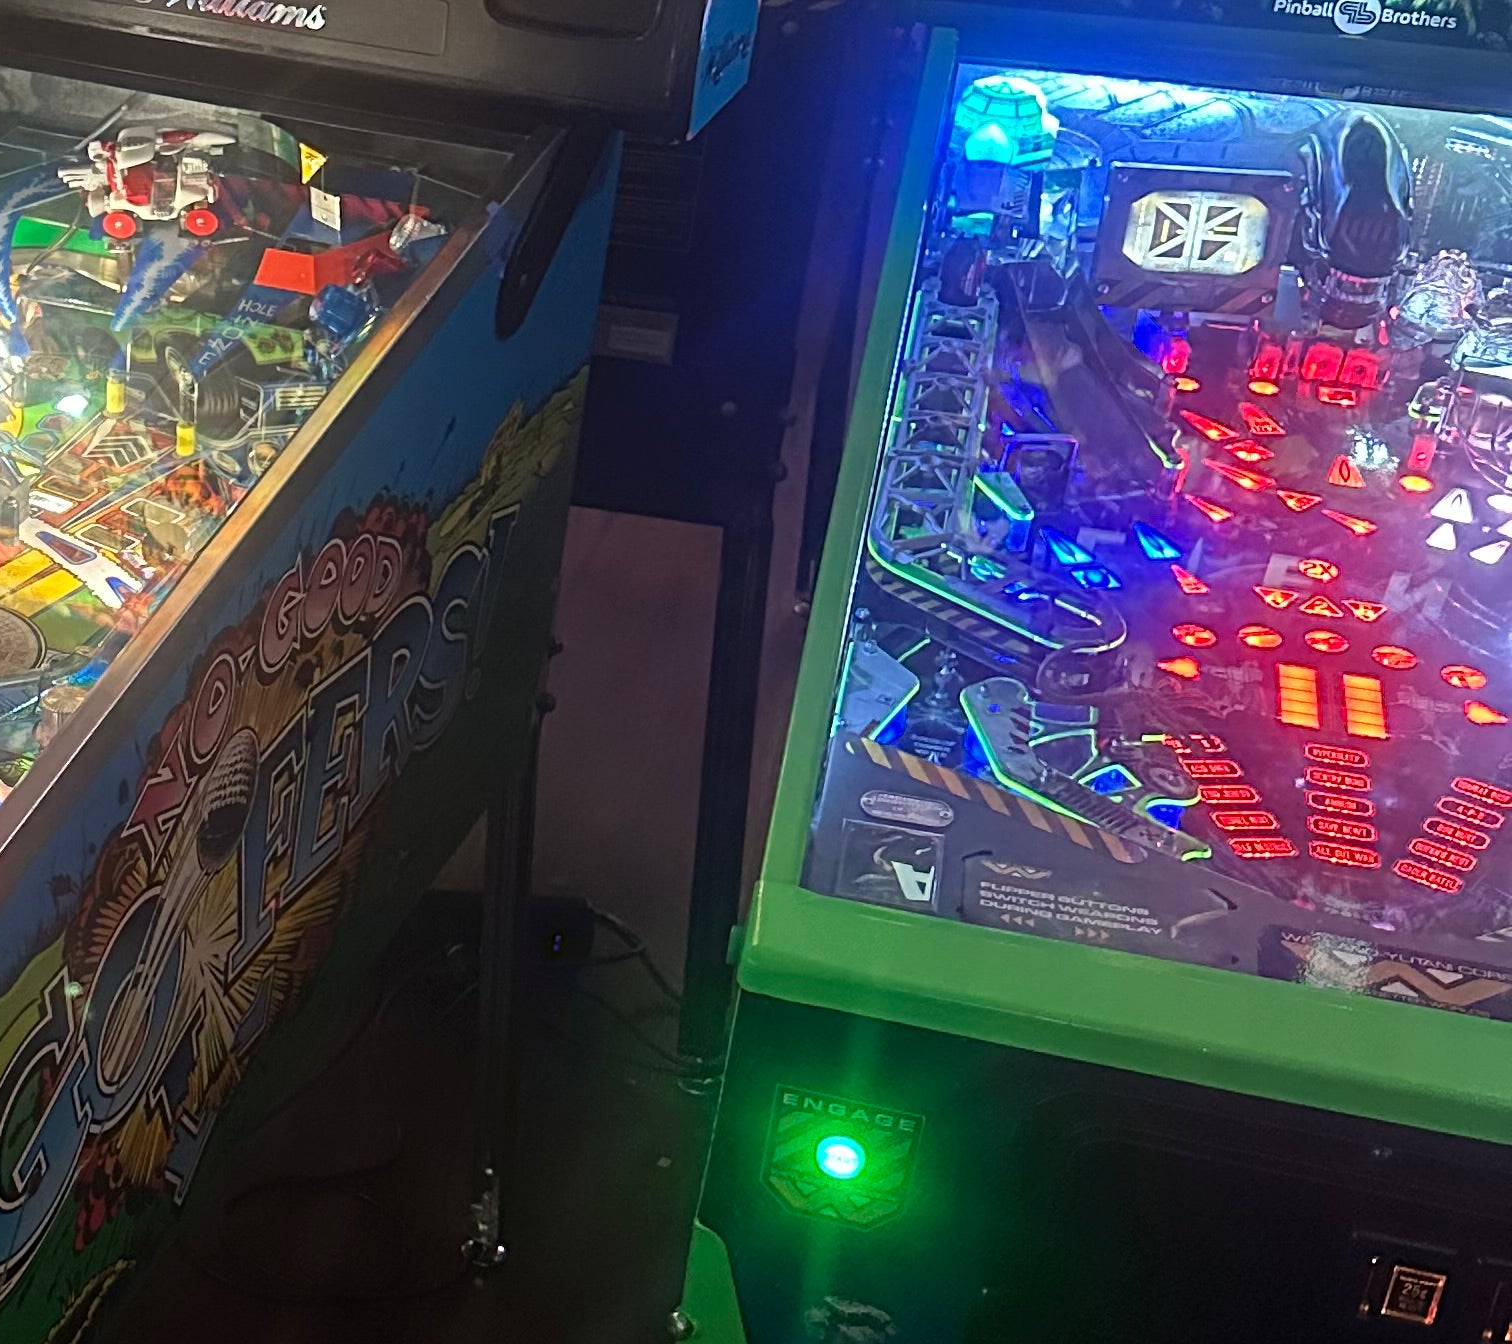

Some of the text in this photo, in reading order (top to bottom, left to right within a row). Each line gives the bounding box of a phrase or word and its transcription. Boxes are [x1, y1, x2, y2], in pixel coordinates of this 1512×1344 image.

[1380, 7, 1457, 30] Brothers
[1303, 560, 1336, 579] 2X
[979, 890, 1159, 926] SWITCH WEAPONS
[980, 881, 1150, 916] FLIPPER BUTTONS
[979, 898, 1163, 936] DURING GAMEPLAY
[782, 1092, 917, 1133] ENGAGE
